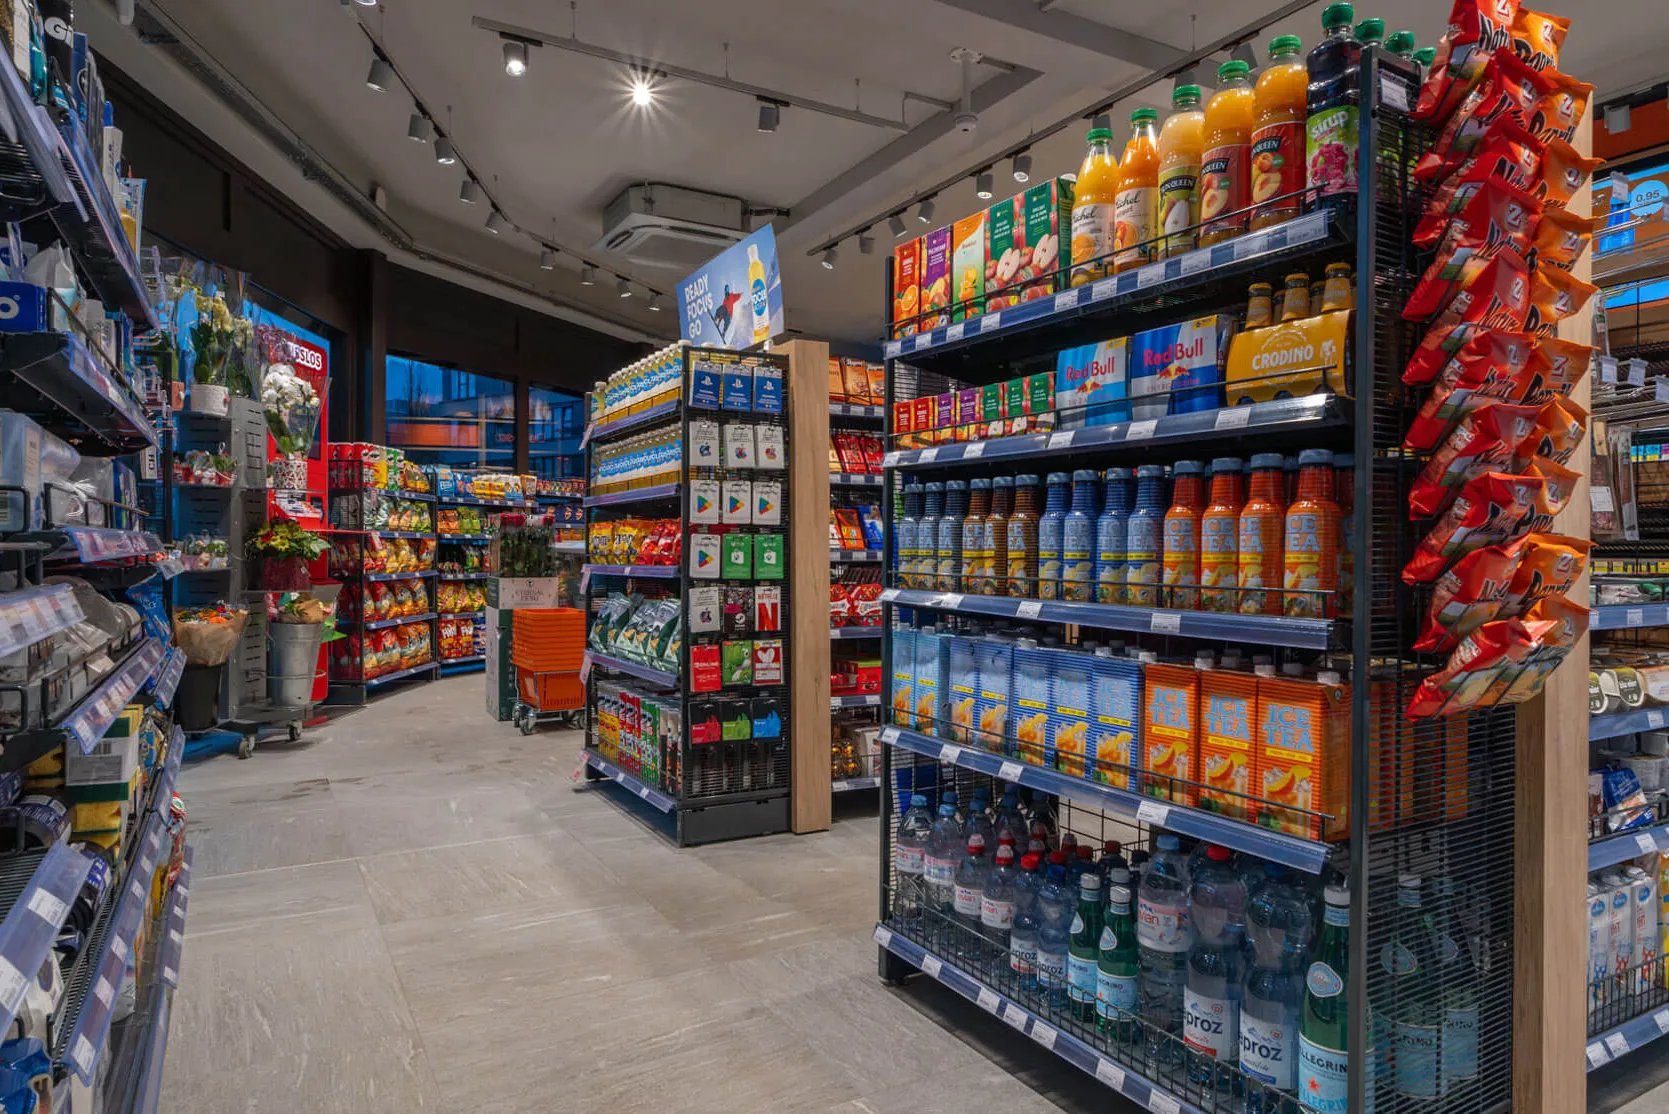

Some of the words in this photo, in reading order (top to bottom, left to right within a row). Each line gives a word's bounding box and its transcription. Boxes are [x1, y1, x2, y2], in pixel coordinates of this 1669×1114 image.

[1312, 111, 1348, 138] sirup
[1115, 191, 1141, 208] ichel
[1635, 189, 1660, 203] 0.95
[684, 274, 708, 304] READY
[687, 292, 713, 321] FOCUS
[688, 319, 702, 339] GO
[1143, 344, 1172, 367] Red
[1175, 337, 1204, 361] Bull
[1252, 344, 1314, 371] CRODINO
[1066, 363, 1089, 382] Red
[1091, 356, 1116, 377] Bull
[758, 602, 778, 631] N
[1138, 911, 1160, 925] vian
